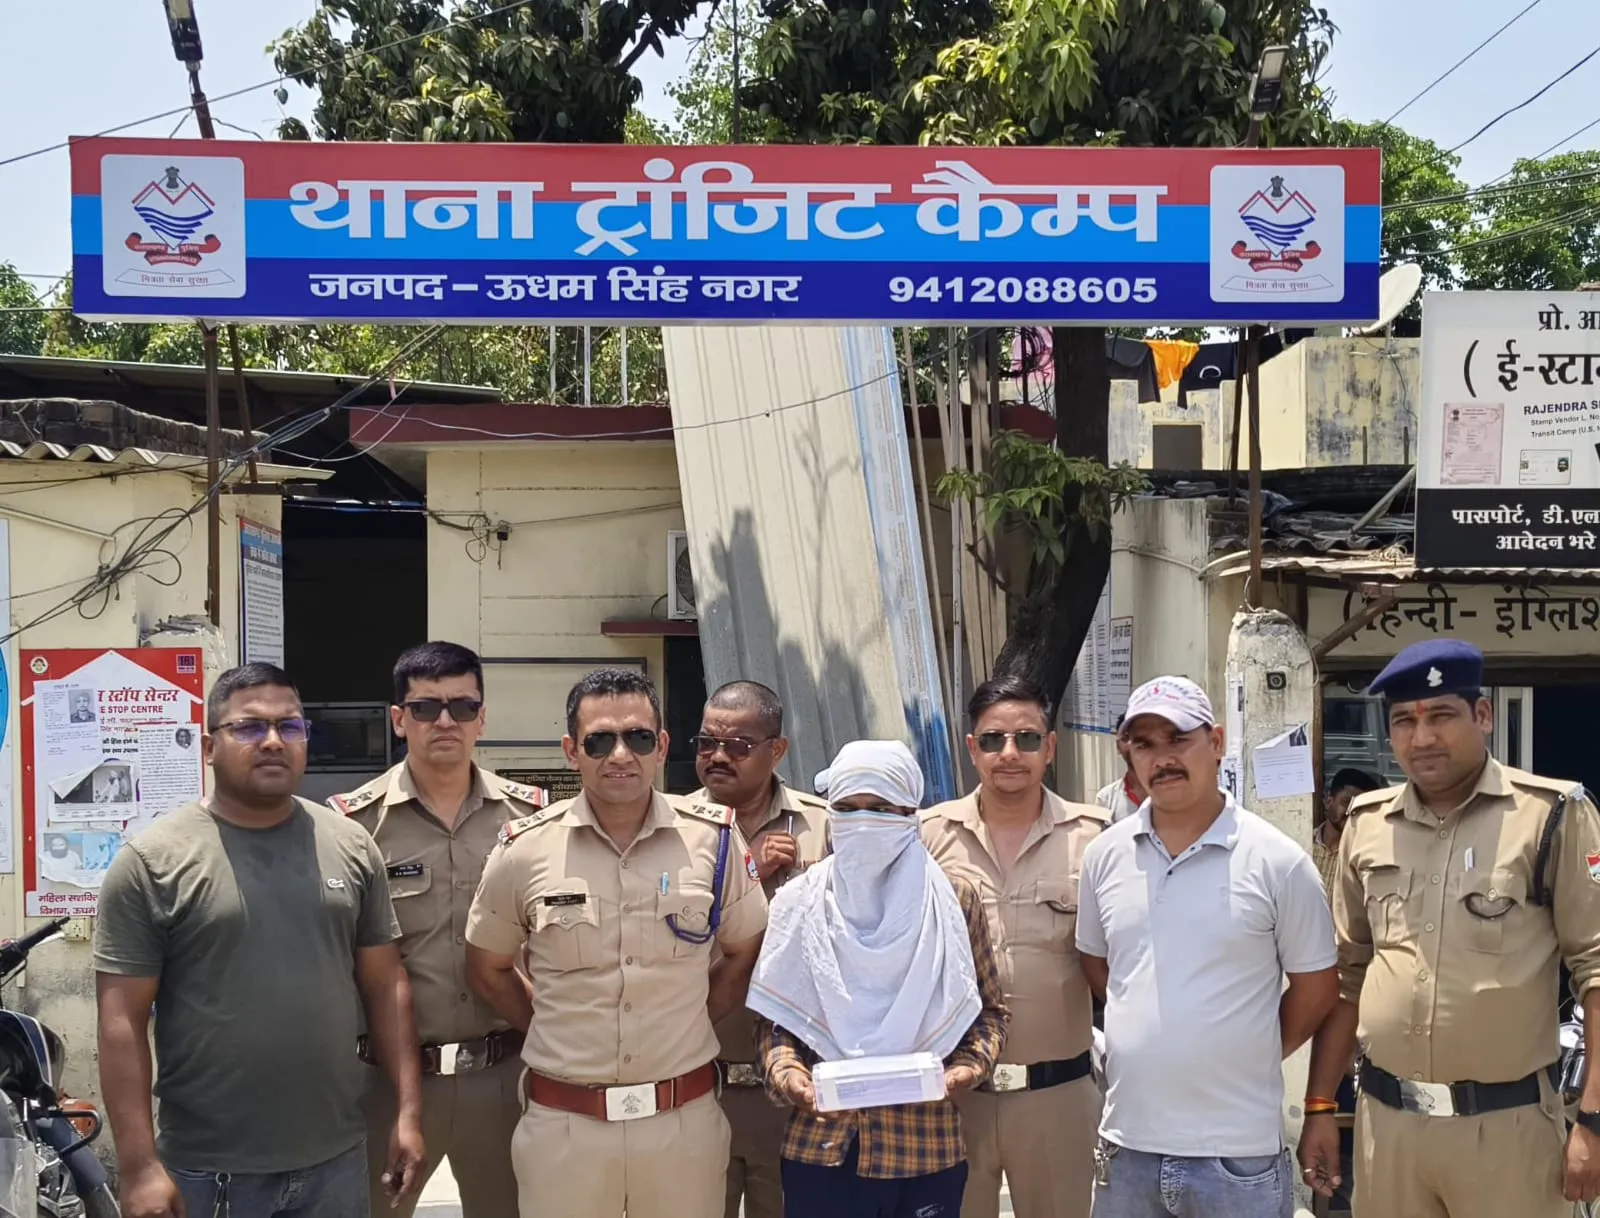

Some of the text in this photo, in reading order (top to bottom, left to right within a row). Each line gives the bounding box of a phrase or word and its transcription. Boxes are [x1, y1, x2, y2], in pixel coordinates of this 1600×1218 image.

[290, 159, 1169, 255] थाना ट्रांजिट कैम्प
[310, 275, 447, 299] जनपद
[486, 276, 596, 300] ऊधम
[607, 266, 692, 301] सिंह
[700, 277, 801, 300] नगर
[889, 277, 1158, 303] 9412088605
[1538, 303, 1570, 331] प्रो.
[1496, 339, 1600, 392] ई-स्टा
[1523, 402, 1588, 415] RAJENDRA
[1555, 415, 1579, 424] Vendor
[1531, 430, 1555, 438] Transit
[1556, 428, 1577, 436] Camp
[1451, 503, 1532, 526] पासपोर्ट,
[1496, 530, 1565, 550] आवेदन
[108, 687, 141, 702] स्टॉप
[108, 705, 129, 713] STOP
[131, 705, 163, 713] CENTRE
[39, 892, 66, 902] महिला
